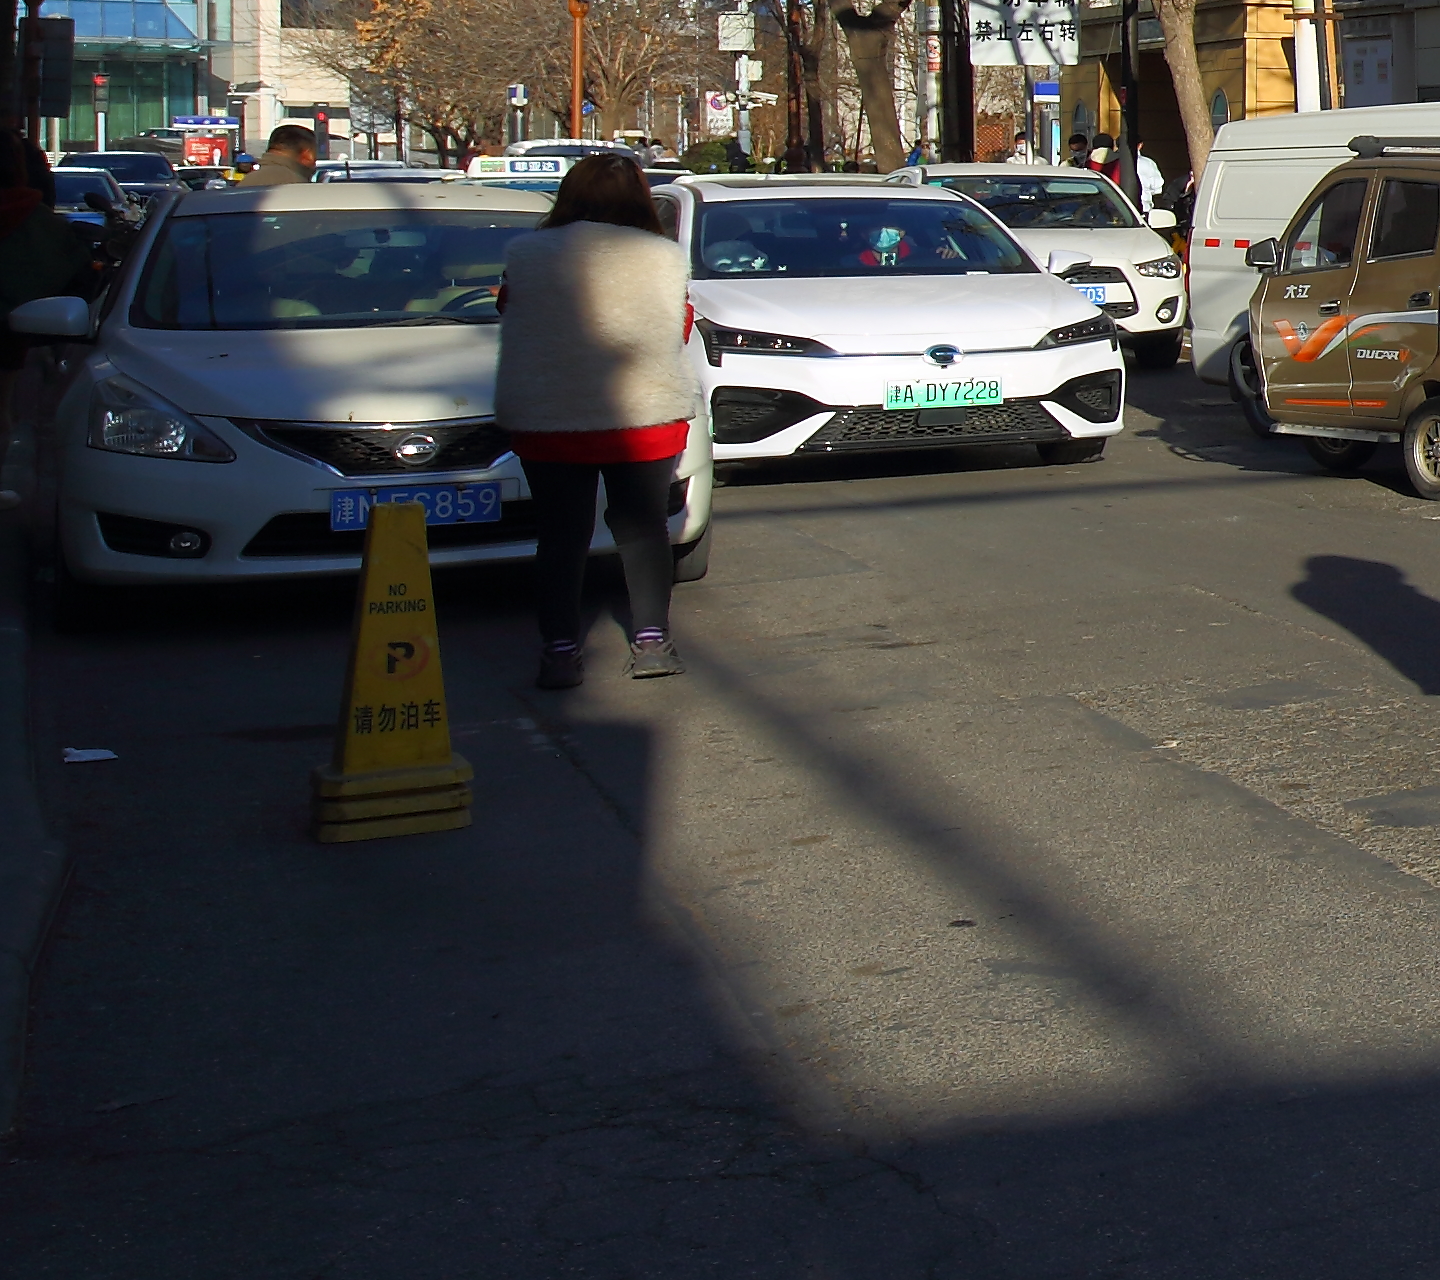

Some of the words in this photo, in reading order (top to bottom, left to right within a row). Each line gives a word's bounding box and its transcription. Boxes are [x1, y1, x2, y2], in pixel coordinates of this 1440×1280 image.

[975, 19, 1077, 43] 禁止左右转
[1283, 284, 1312, 299] 大江
[389, 583, 407, 596] NO
[369, 598, 427, 615] PARKING
[354, 699, 442, 734] 请勿泊车
